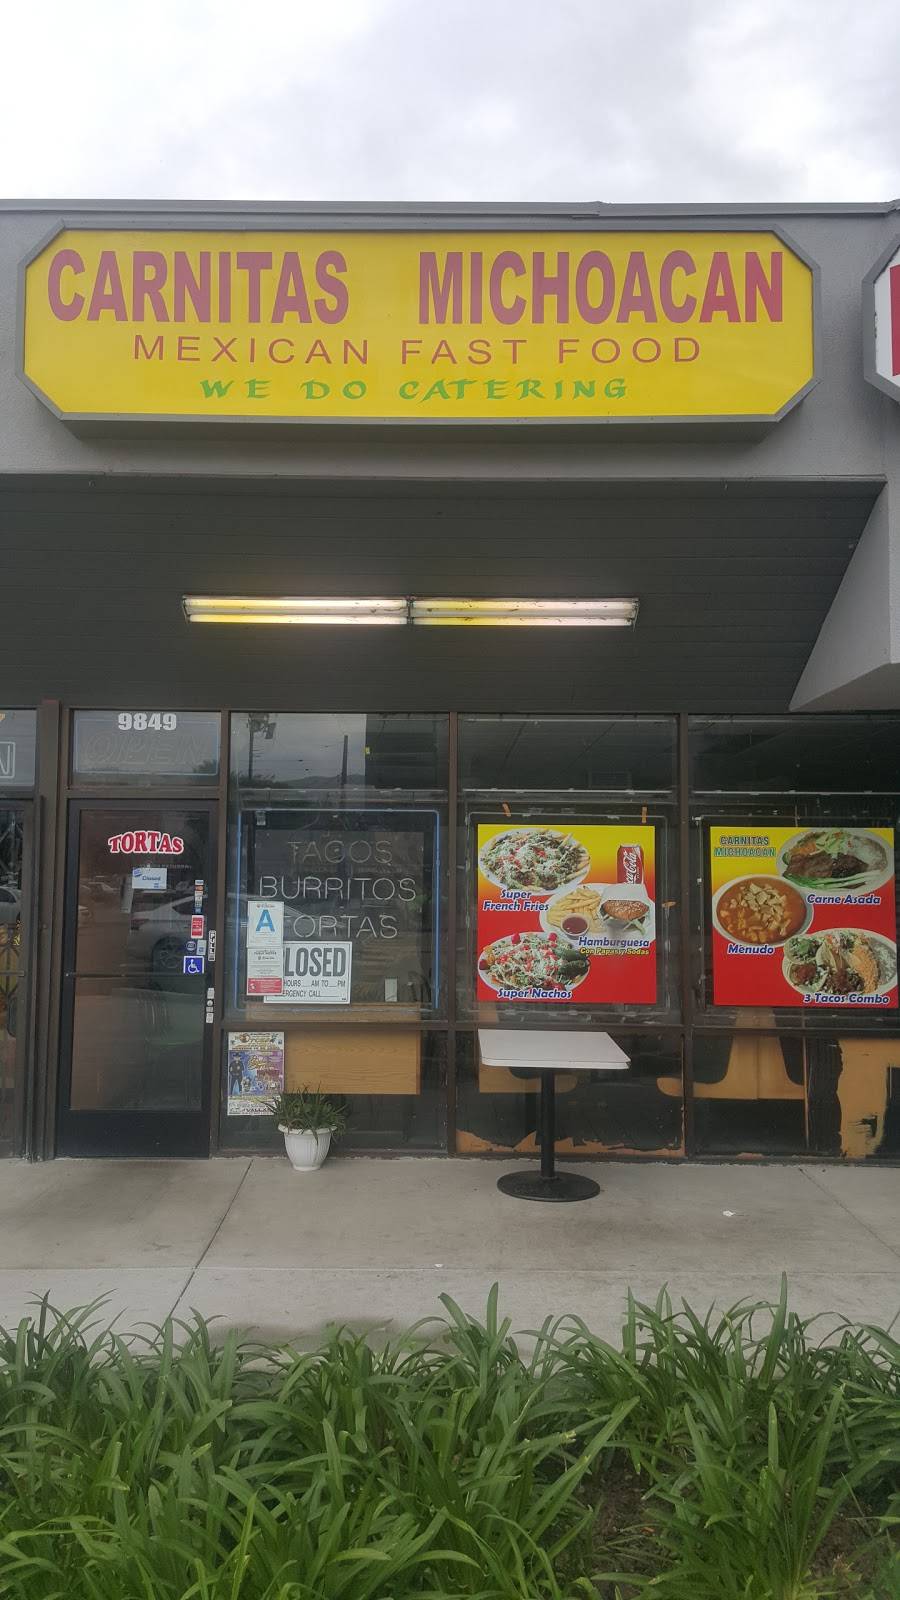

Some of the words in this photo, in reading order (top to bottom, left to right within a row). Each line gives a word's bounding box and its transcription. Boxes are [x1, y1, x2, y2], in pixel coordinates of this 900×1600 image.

[48, 249, 349, 325] CARNITAS
[418, 250, 783, 325] MICHOACAN
[133, 334, 368, 365] MEXICAN
[401, 338, 527, 365] FAST
[558, 336, 701, 364] FOOD
[199, 379, 271, 400] WE
[299, 380, 367, 400] DO
[399, 378, 628, 402] CATERING
[118, 712, 177, 732] 9849
[108, 831, 184, 855] TORTAS
[719, 835, 769, 846] CARNITAS
[287, 840, 392, 864] TACOS
[259, 875, 416, 902] BURRITOS
[500, 890, 531, 900] Super
[483, 901, 520, 911] French
[523, 901, 549, 911] Fries
[807, 894, 841, 904] Carne
[844, 894, 881, 904] Asada
[256, 909, 275, 932] A
[579, 936, 650, 948] Hamburguesa
[727, 944, 775, 954] Menudo
[285, 947, 347, 977] LOSED
[497, 988, 529, 999] Super
[530, 988, 573, 998] Nachos
[804, 993, 810, 1003] 3
[814, 993, 845, 1003] Tacos
[847, 993, 890, 1003] Combo
